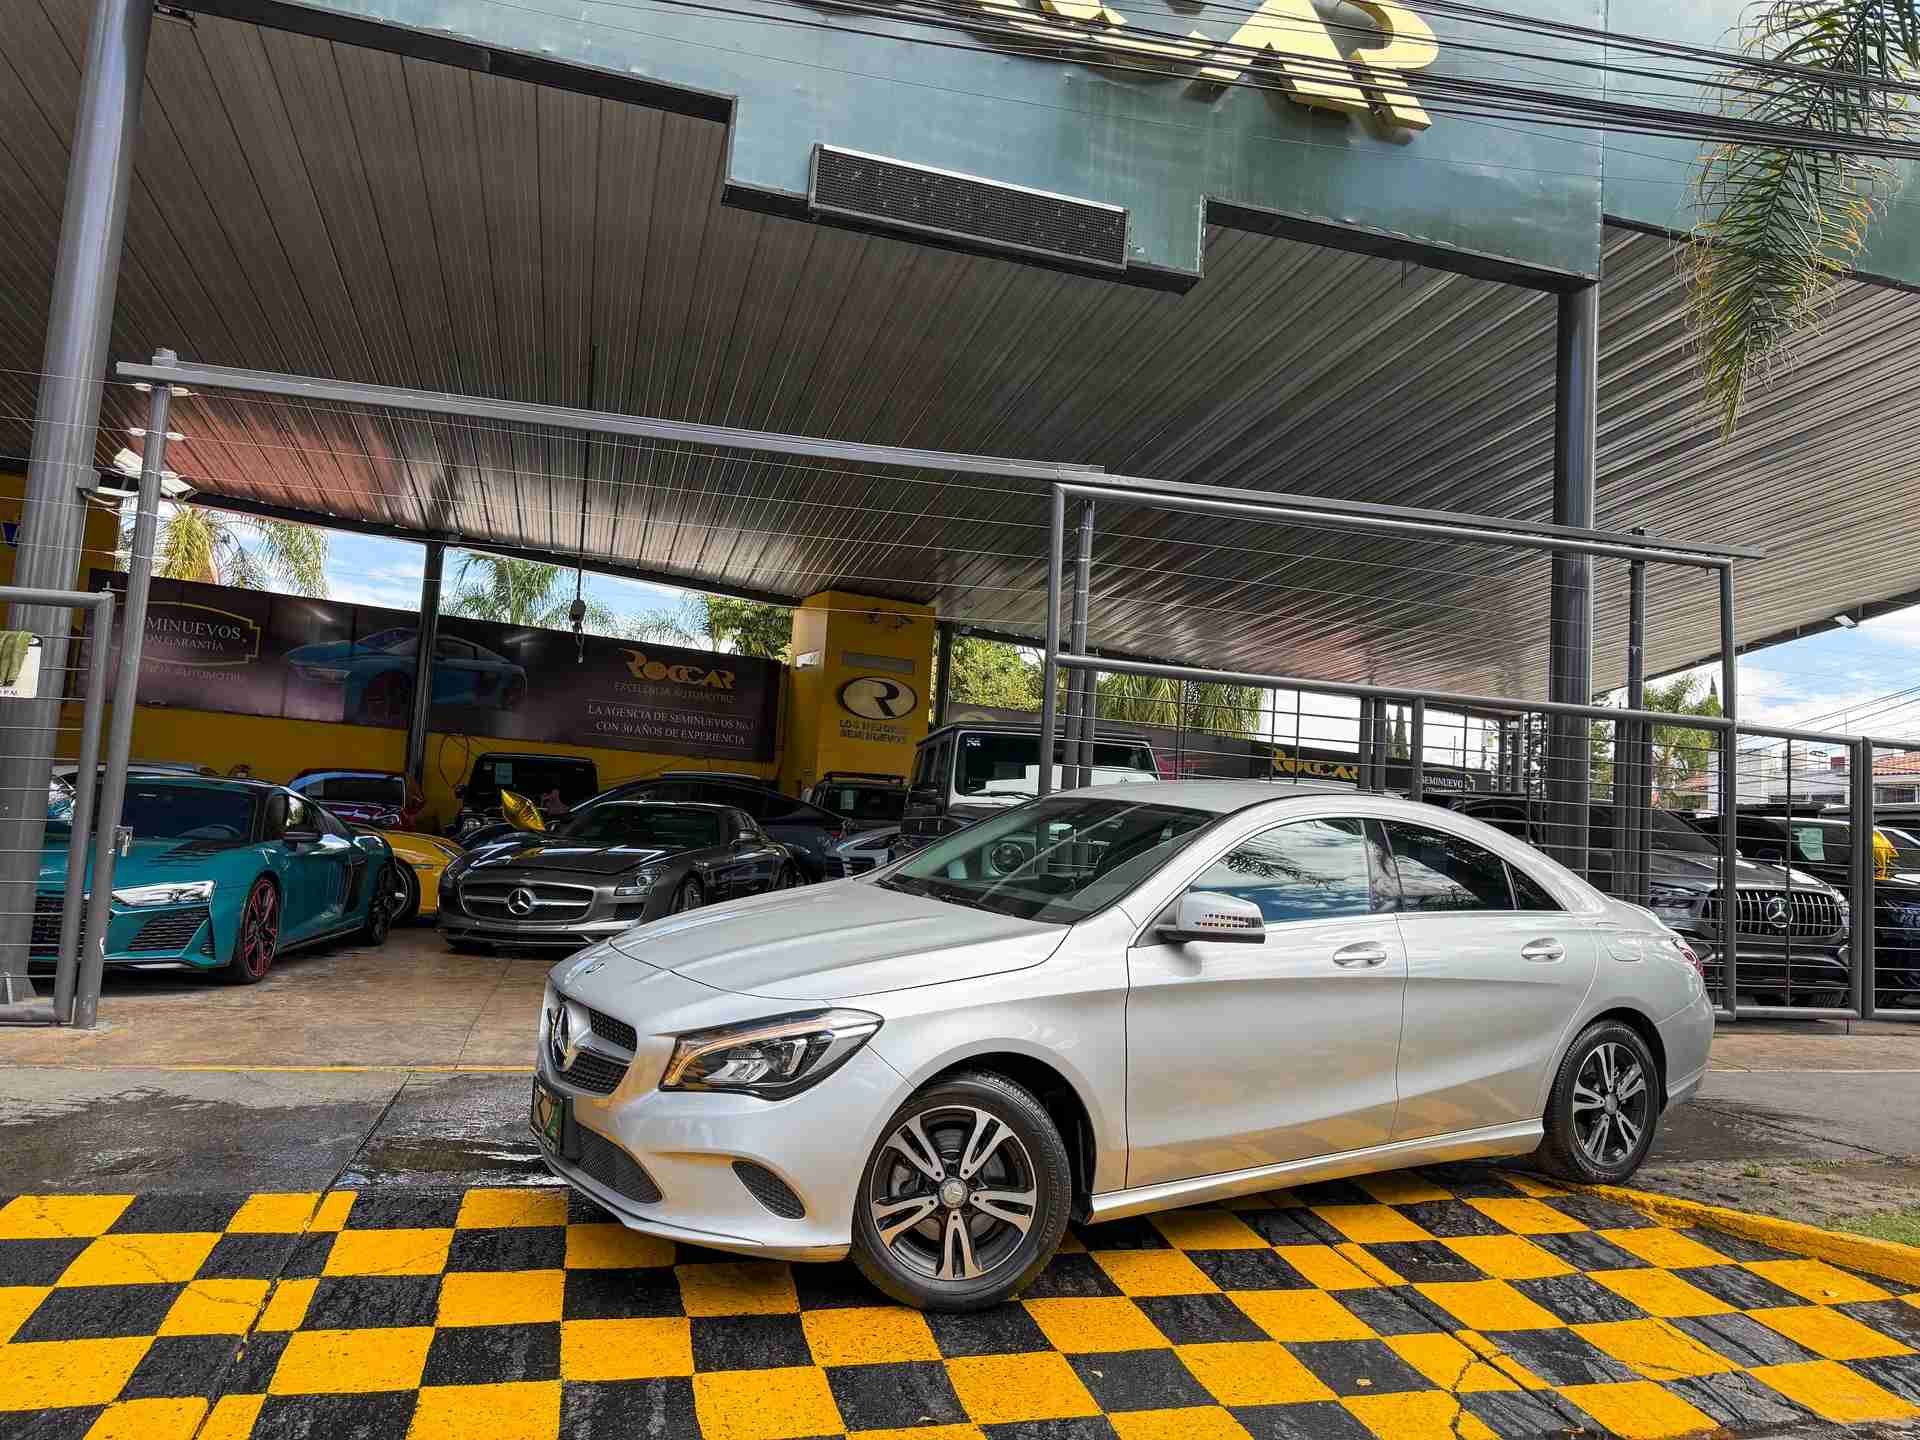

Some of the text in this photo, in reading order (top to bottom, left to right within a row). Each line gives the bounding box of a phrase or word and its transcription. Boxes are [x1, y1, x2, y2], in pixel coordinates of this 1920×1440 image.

[143, 616, 242, 640] MINUEVOS
[588, 703, 602, 715] LA
[604, 704, 651, 721] AGENCIA
[654, 711, 670, 722] DE
[671, 713, 734, 729] SEMINUEVOS
[595, 720, 619, 732] CON
[634, 721, 663, 737] AÑOS
[666, 727, 680, 738] DE
[681, 728, 746, 745] EXPERIENCIA
